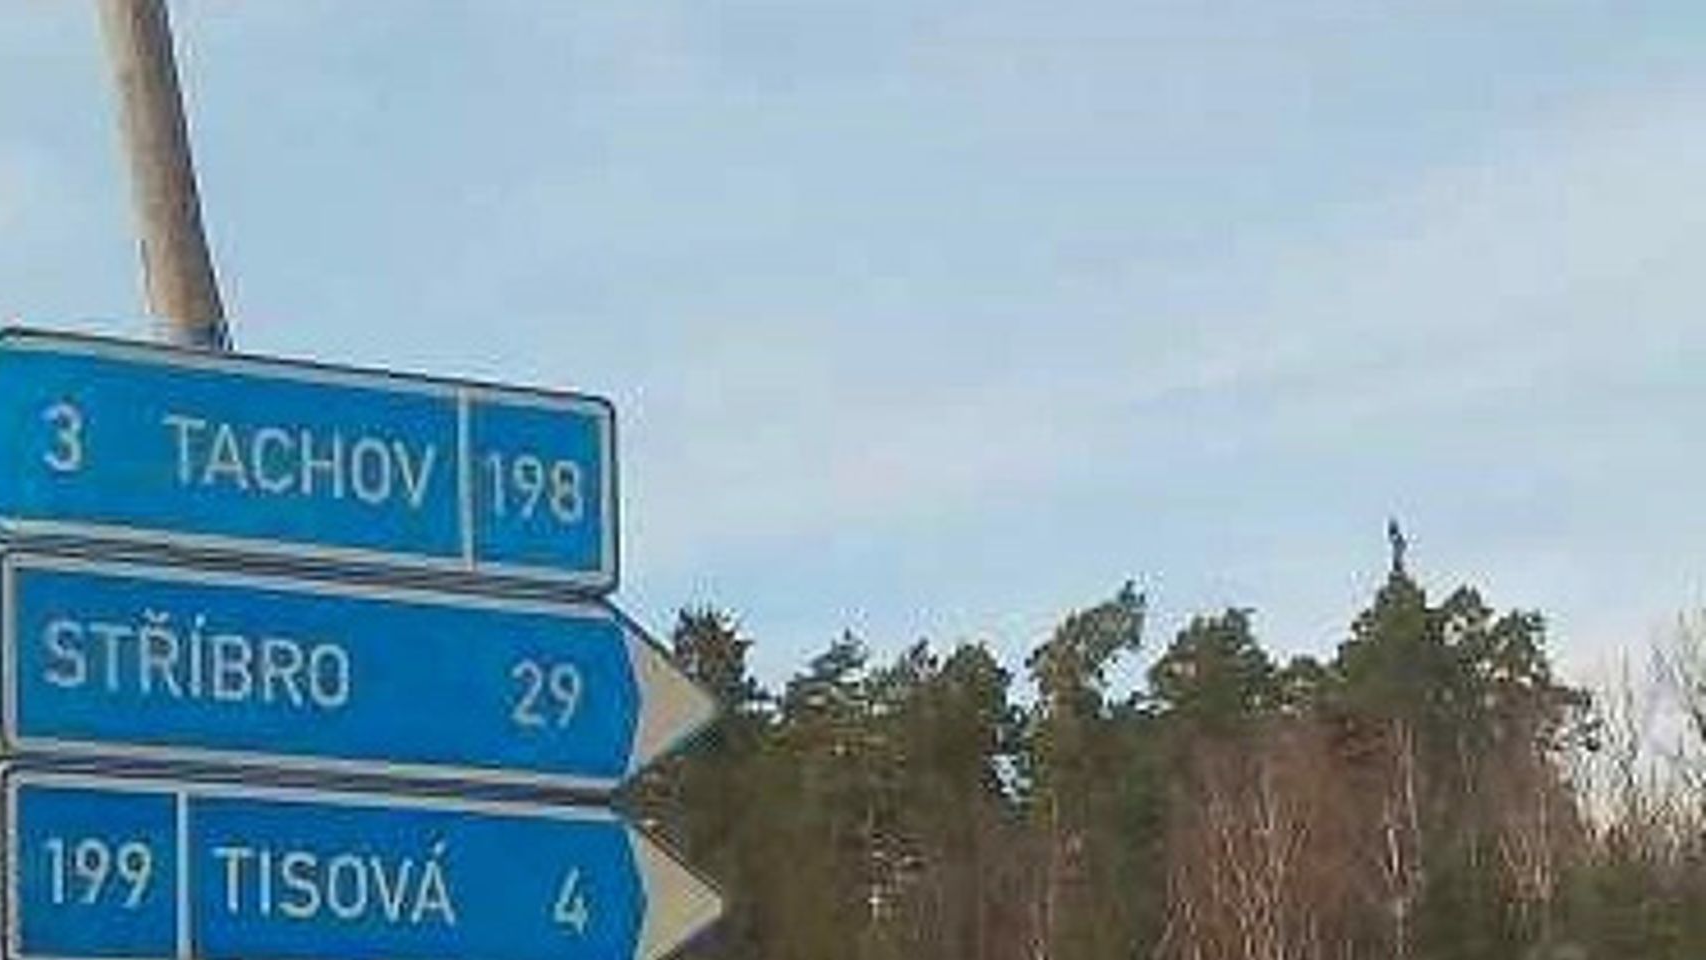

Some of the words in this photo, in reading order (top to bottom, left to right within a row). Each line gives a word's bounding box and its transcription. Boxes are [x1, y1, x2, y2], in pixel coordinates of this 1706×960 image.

[41, 401, 85, 473] 3
[162, 413, 436, 510] TACHOV
[483, 453, 585, 524] 198
[43, 607, 352, 709] STŘÍBRO
[510, 660, 585, 729] 29
[44, 835, 155, 908] 199
[212, 838, 457, 926] TISOVÁ
[552, 868, 591, 936] 4
